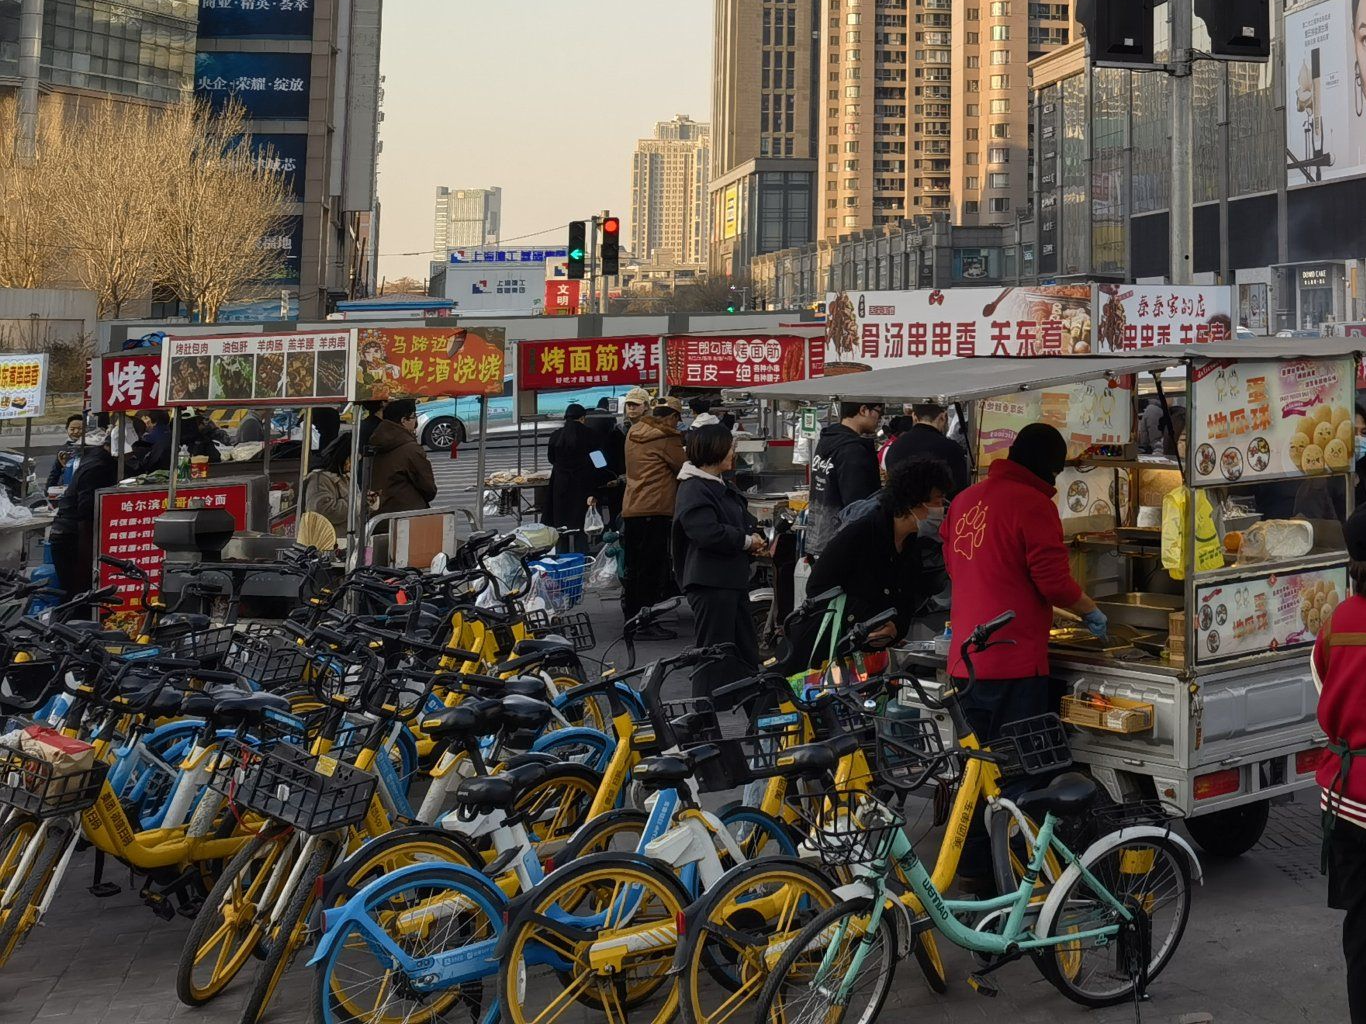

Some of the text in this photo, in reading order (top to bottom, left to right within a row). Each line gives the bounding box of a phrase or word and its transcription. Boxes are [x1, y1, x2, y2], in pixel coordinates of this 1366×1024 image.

[556, 283, 570, 306] 文明
[1137, 293, 1206, 319] 秦秦家的店
[257, 339, 283, 351] 羊肉肠
[319, 336, 346, 349] 羊肉串
[391, 334, 448, 354] 马路边
[687, 339, 781, 362] 三郎勾魂 烤面筋
[861, 320, 1064, 358] 骨汤串串香 关东煮
[401, 354, 503, 384] 啤酒烧烤
[686, 363, 752, 382] 豆皮一绝
